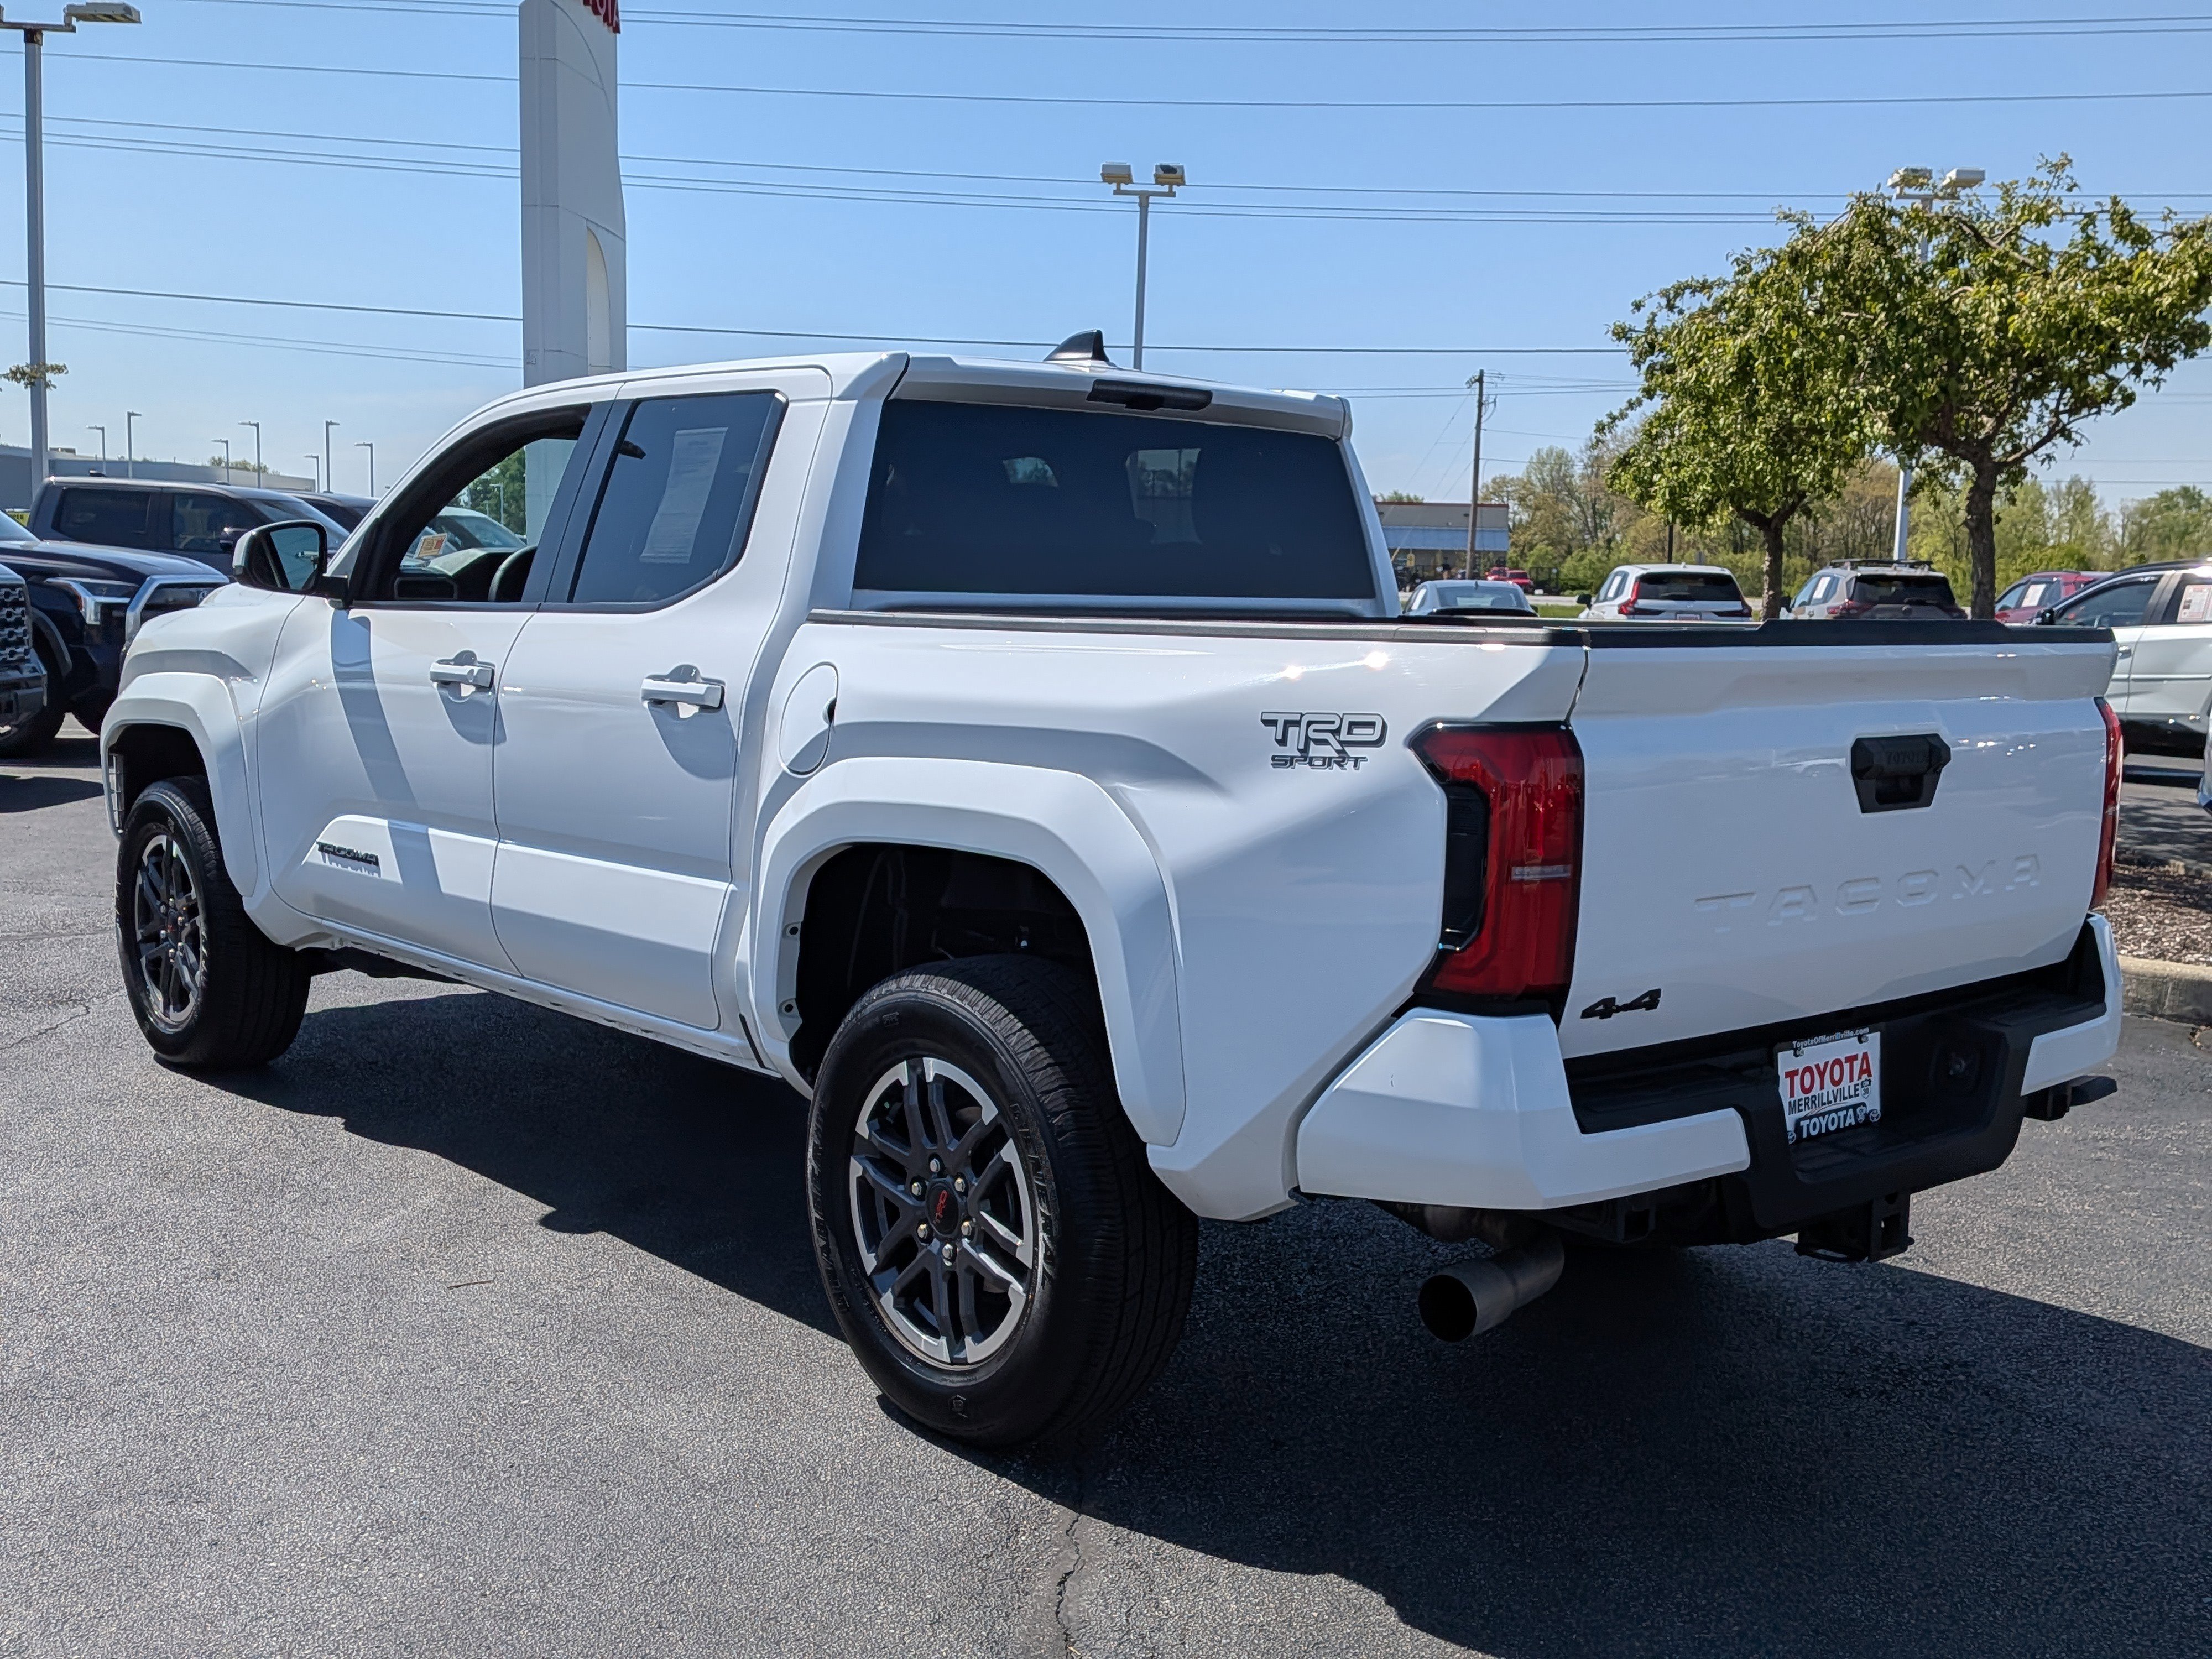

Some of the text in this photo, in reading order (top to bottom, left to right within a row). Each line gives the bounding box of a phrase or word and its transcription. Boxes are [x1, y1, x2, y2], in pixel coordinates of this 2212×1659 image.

[1260, 711, 1388, 757] TRD
[1271, 755, 1368, 770] SPORT
[316, 841, 379, 866] TACOMA
[1694, 854, 2041, 933] TACOMA
[1785, 1052, 1872, 1099] TOYOTA
[1788, 1083, 1860, 1116] MERRILLVILLE
[1800, 1108, 1855, 1139] TOYOTA
